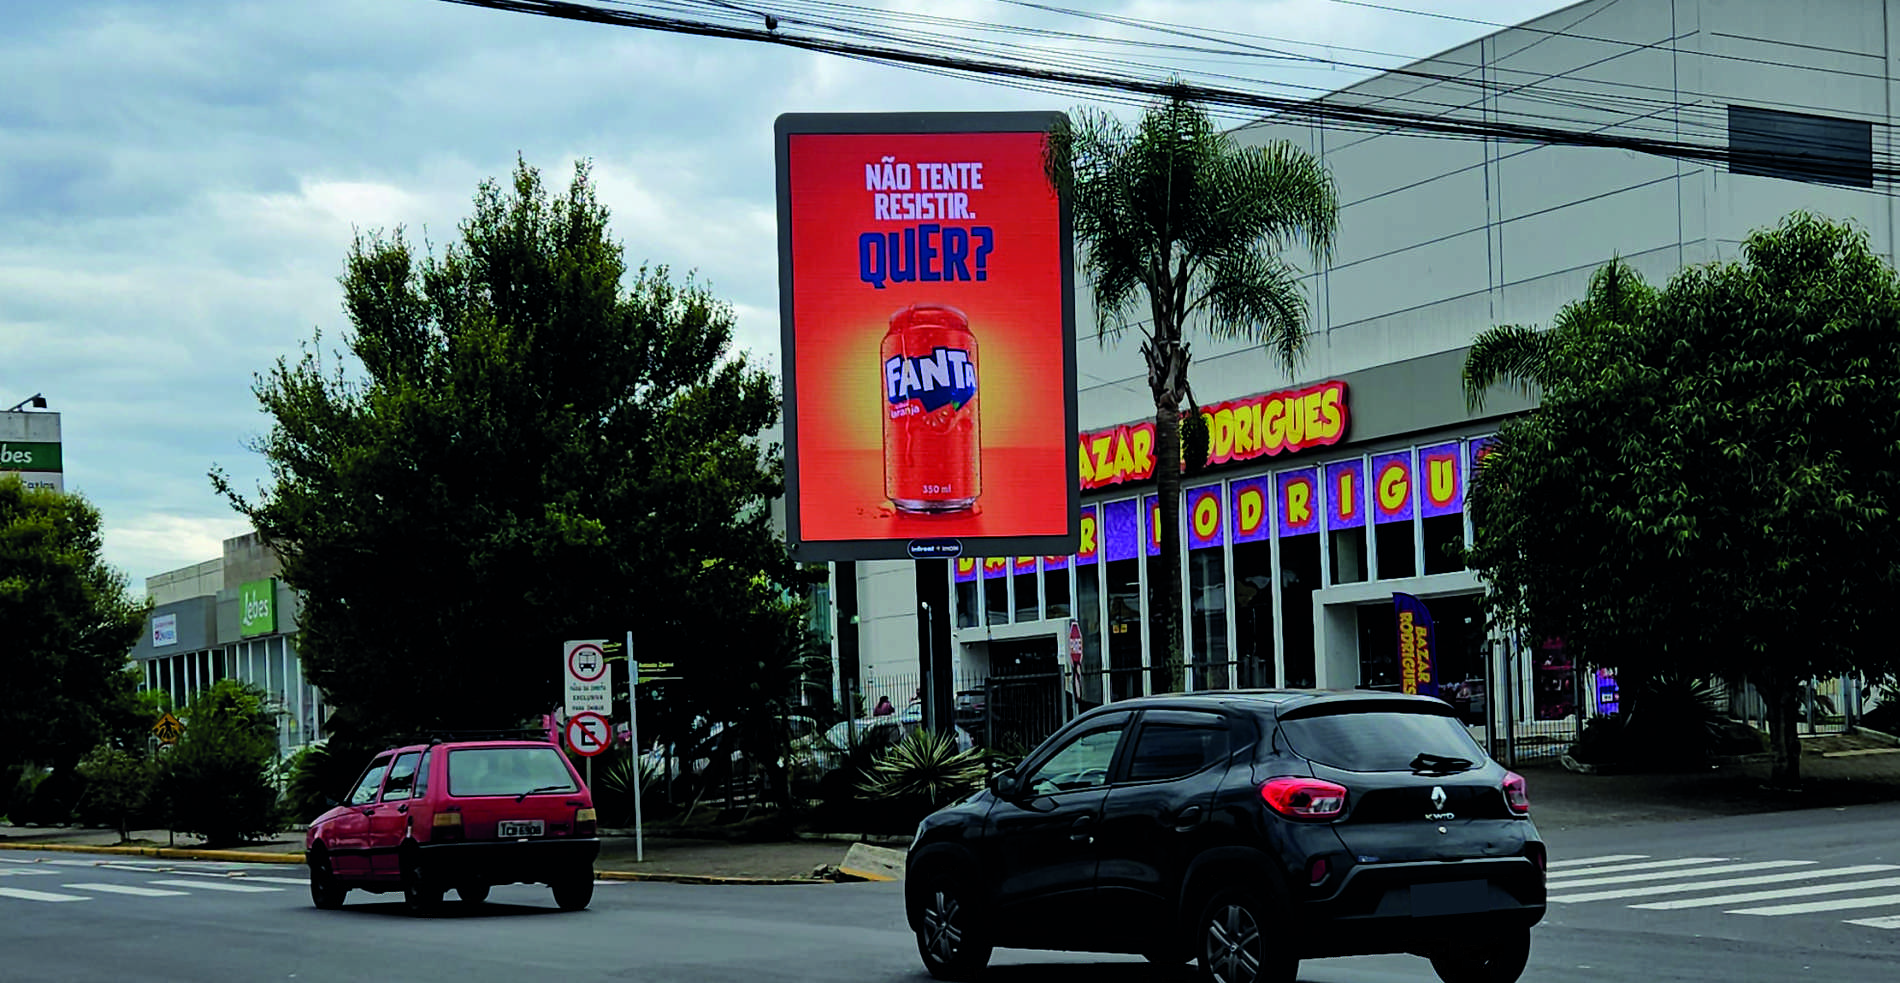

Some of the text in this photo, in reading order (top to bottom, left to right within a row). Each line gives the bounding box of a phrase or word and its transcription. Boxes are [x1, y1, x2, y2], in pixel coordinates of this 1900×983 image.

[865, 155, 983, 190] NÃO TENTE
[874, 192, 976, 220] RESISTIR.
[859, 223, 993, 289] QUER?
[886, 349, 976, 398] FANTA
[1079, 387, 1342, 482] AZAR DRIGUES
[0, 443, 33, 464] bes
[922, 484, 952, 494] 350 ml
[243, 589, 269, 626] Lebes
[1399, 612, 1417, 695] RODRIGUES
[1415, 626, 1431, 683] BAZAR
[581, 721, 597, 746] E
